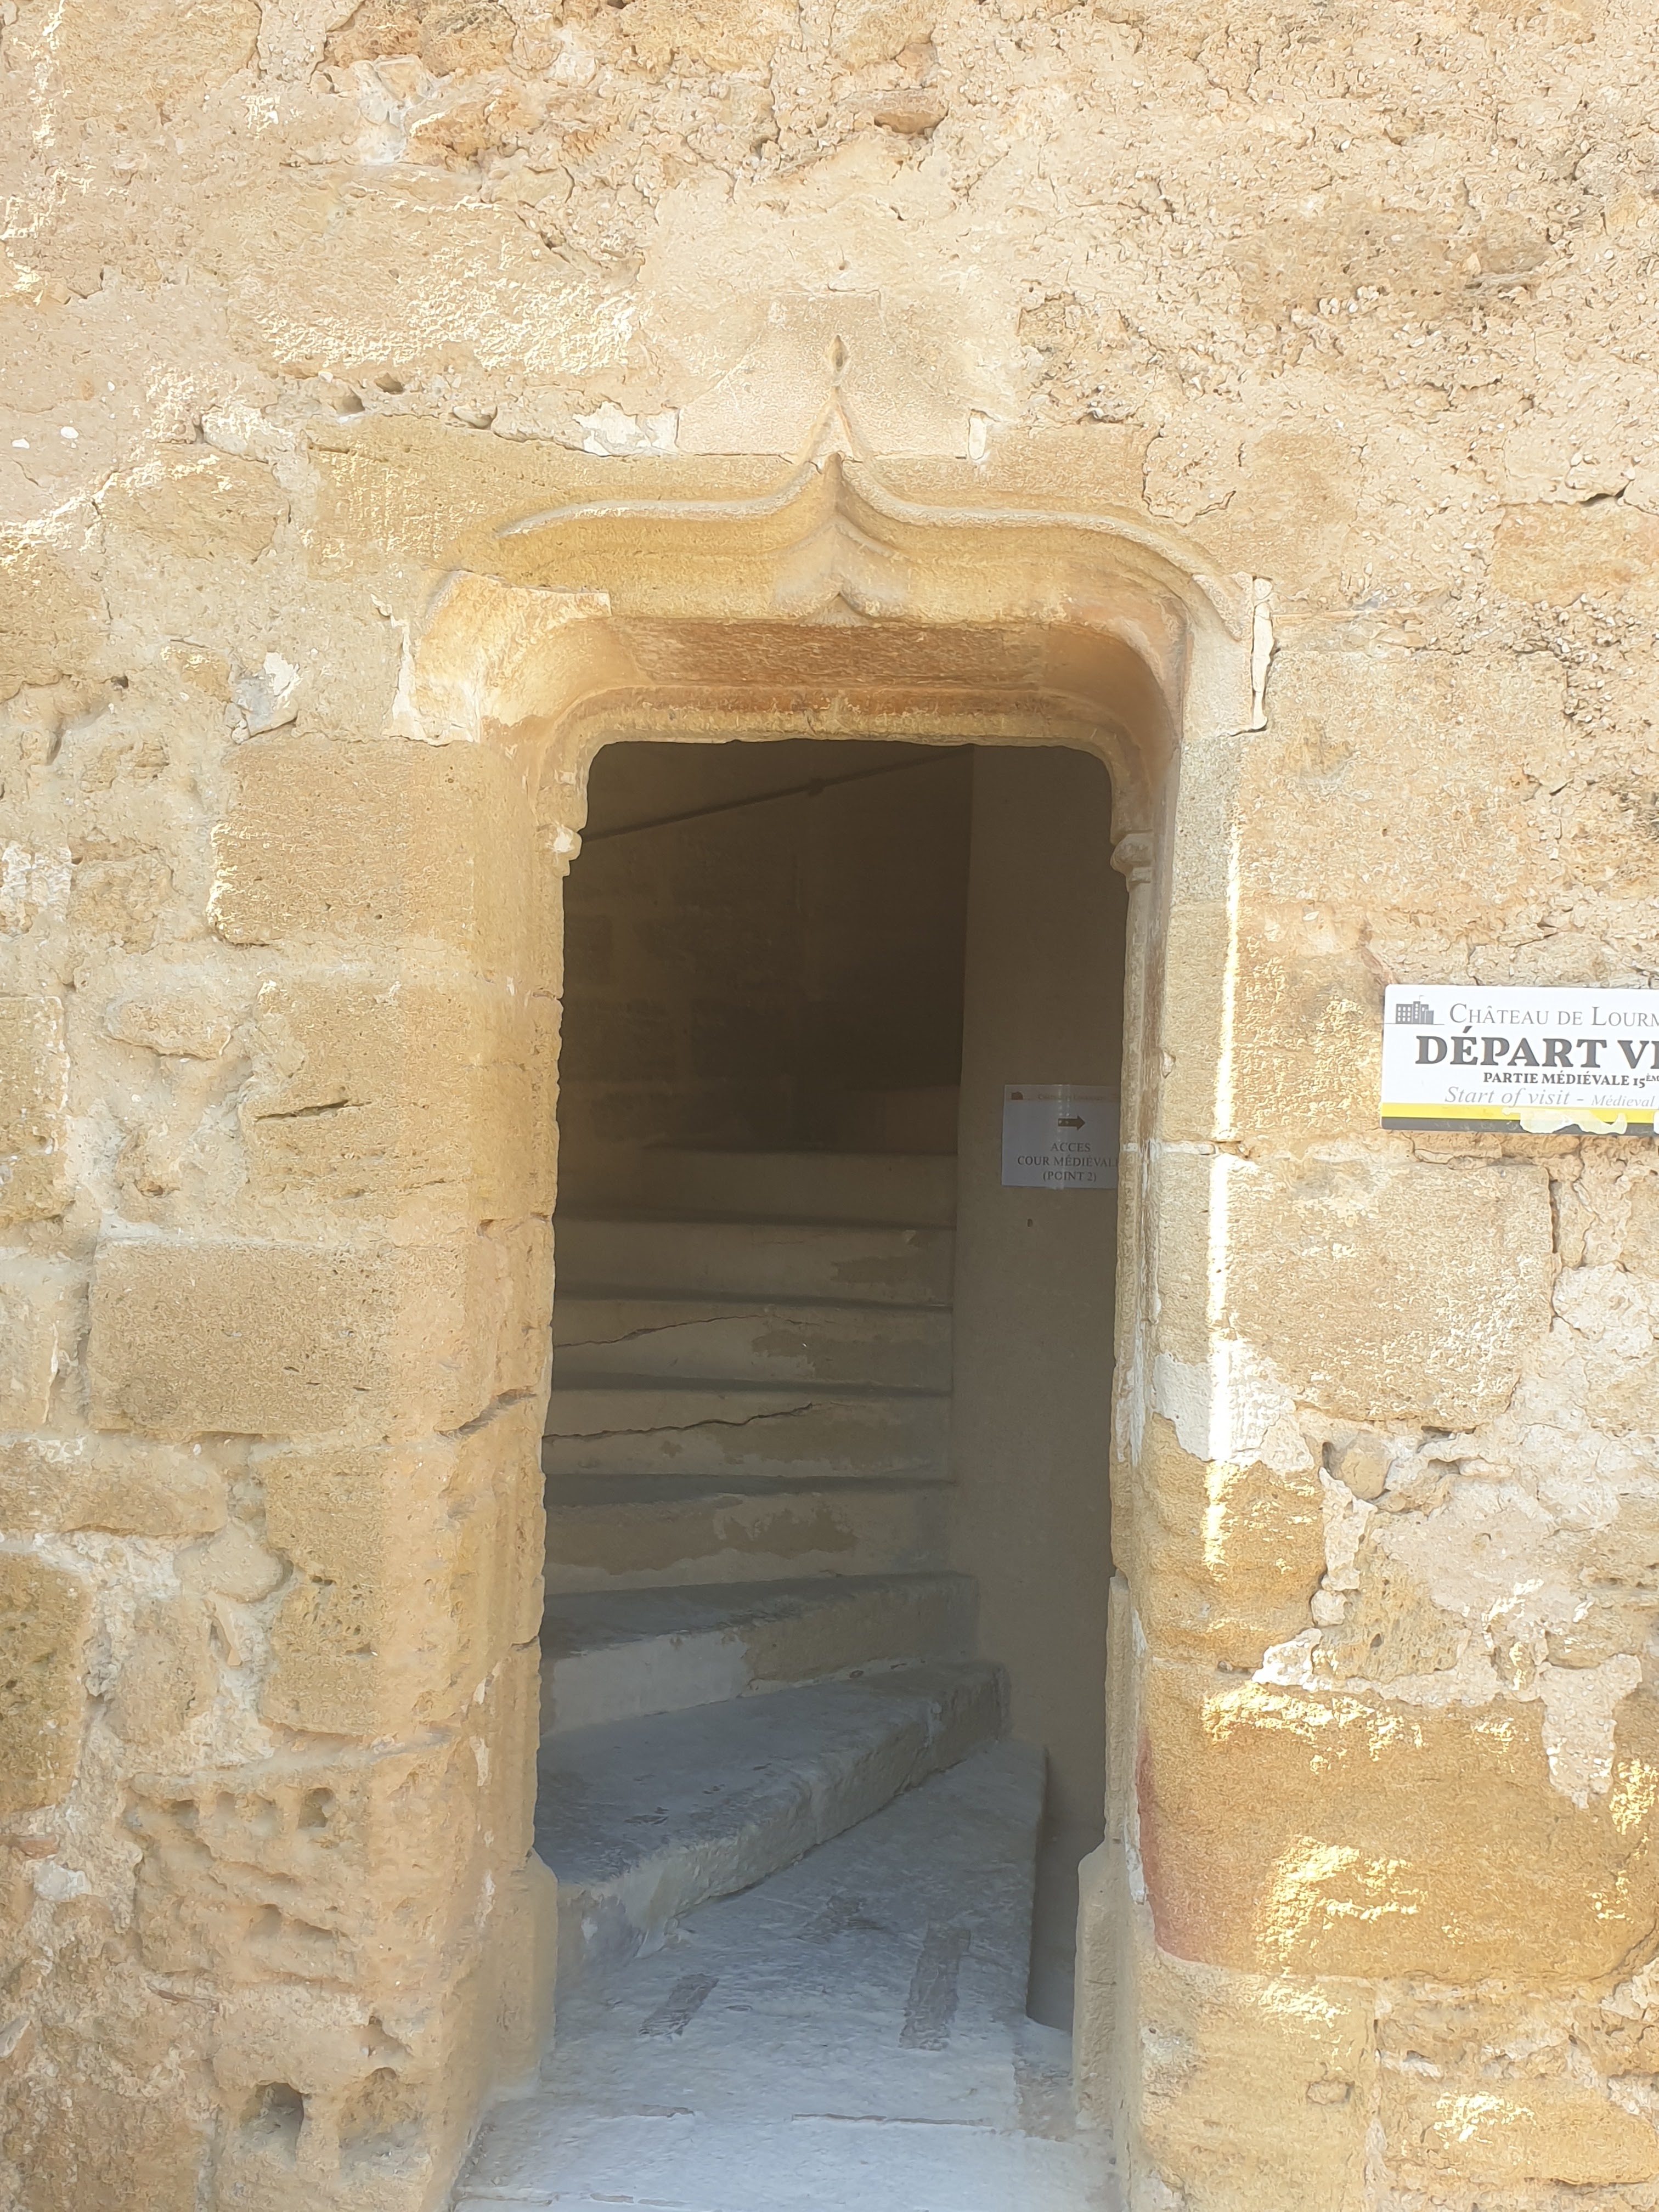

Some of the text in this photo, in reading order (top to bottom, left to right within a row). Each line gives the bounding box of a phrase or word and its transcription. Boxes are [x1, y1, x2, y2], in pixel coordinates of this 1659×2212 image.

[1450, 1003, 1549, 1025] CHÂTEAU
[1557, 1011, 1583, 1025] DE
[1415, 1025, 1607, 1068] DÉPART
[1483, 1073, 1538, 1084] PARTIE
[1542, 1070, 1629, 1086] MÉDIÉVALE
[1444, 1086, 1495, 1103] Start
[1501, 1087, 1526, 1108] of
[1528, 1090, 1571, 1104] visit
[1591, 1094, 1656, 1107] Médieval
[1050, 1142, 1091, 1152] ACCES
[1017, 1155, 1049, 1166] COUR
[1043, 1171, 1097, 1182] (POINT 2)
